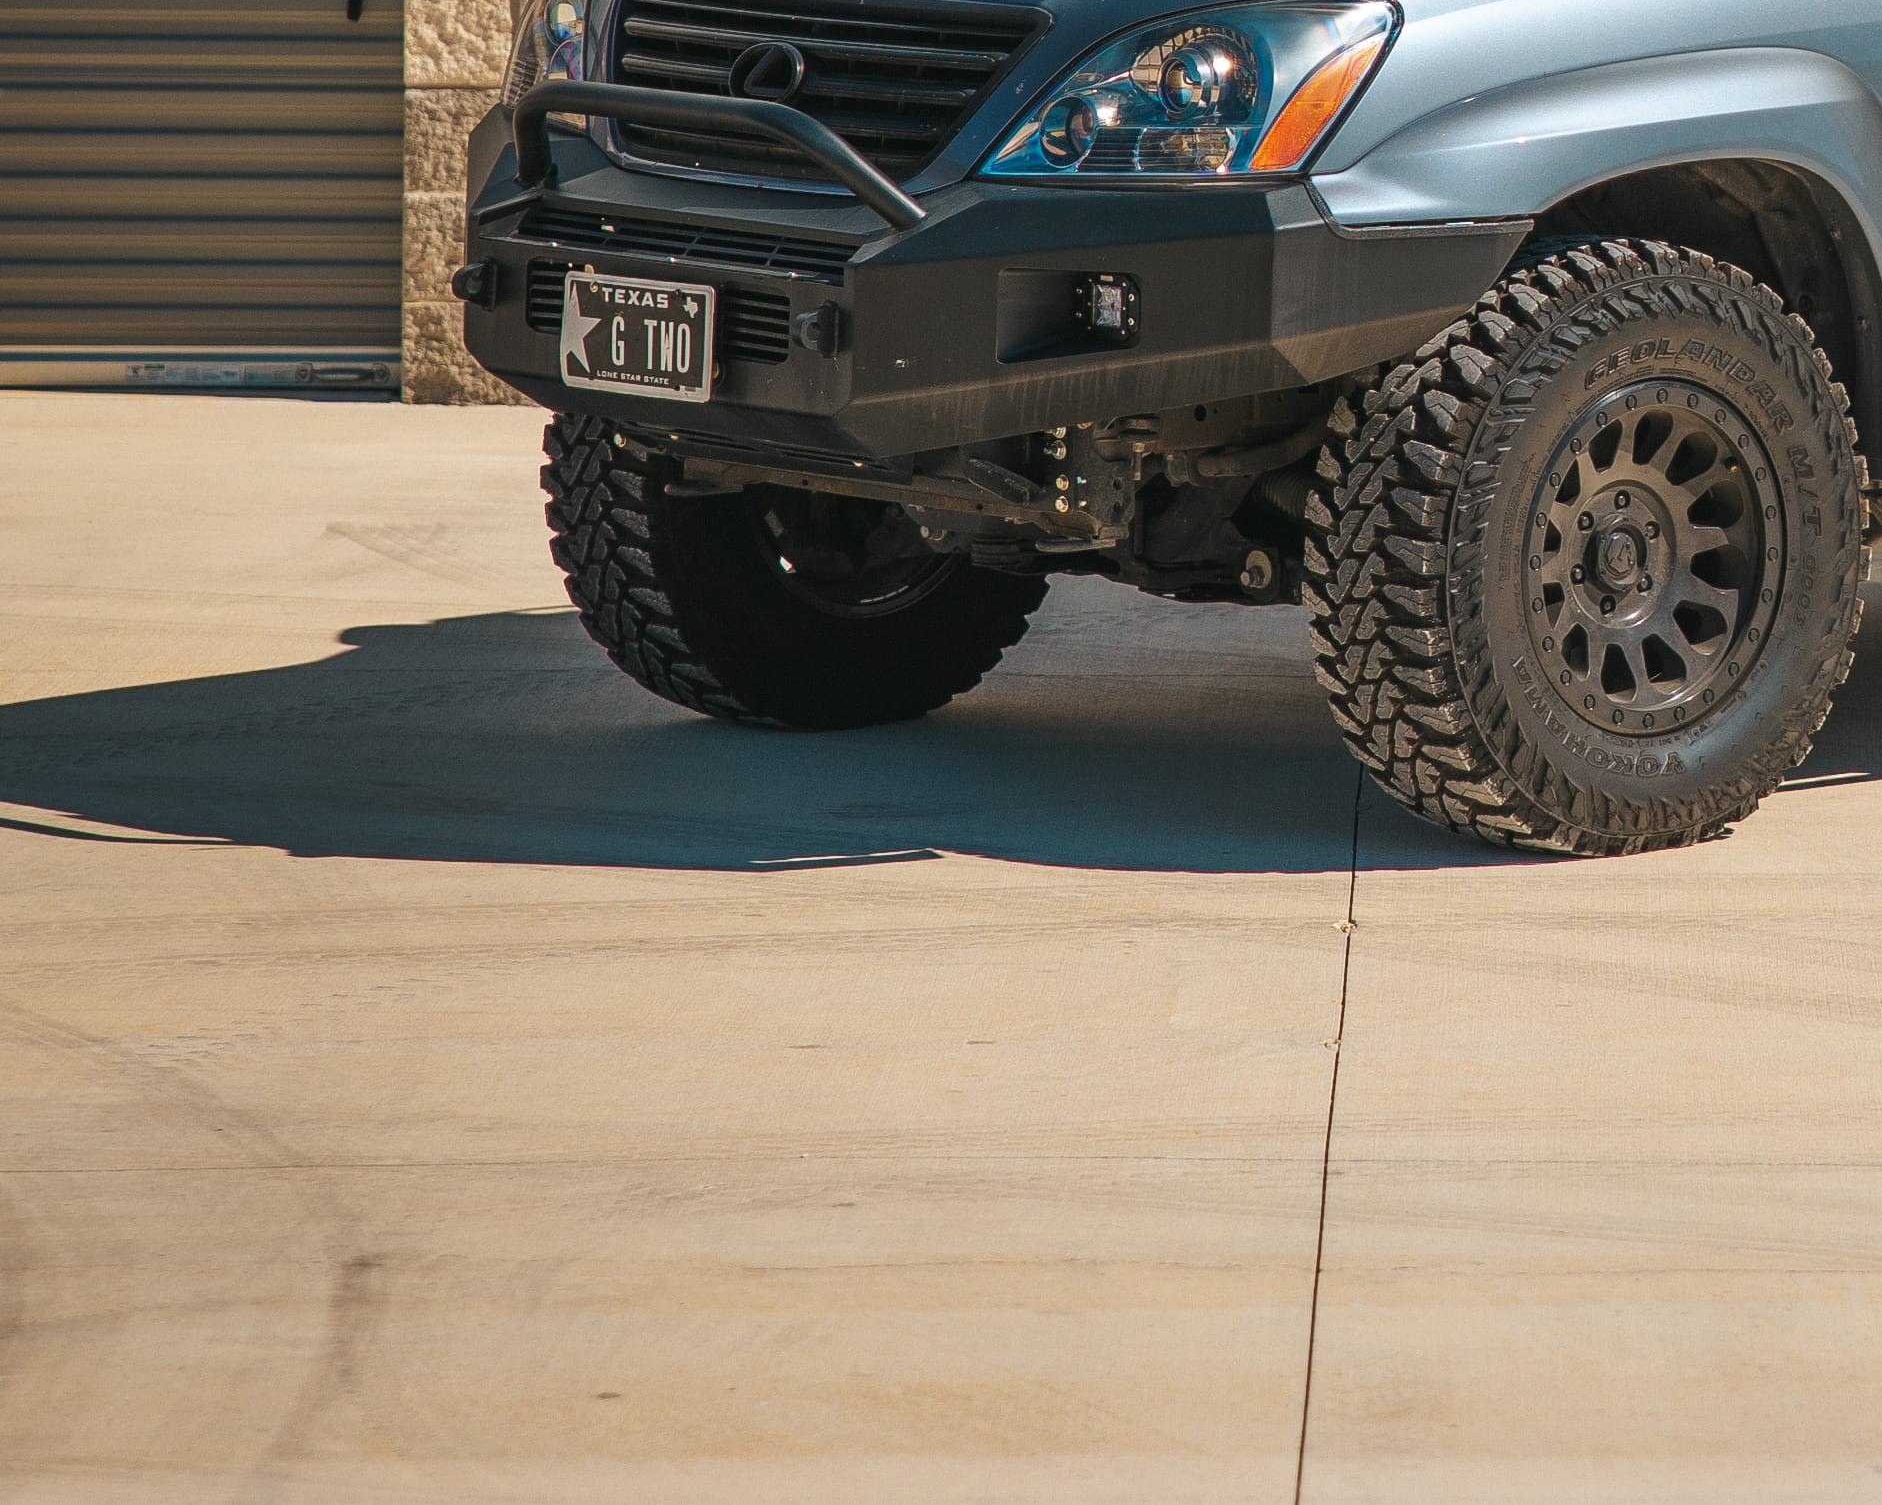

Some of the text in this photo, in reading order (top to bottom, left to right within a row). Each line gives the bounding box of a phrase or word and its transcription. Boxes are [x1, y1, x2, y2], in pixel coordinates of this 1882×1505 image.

[602, 286, 669, 309] TEXAS
[611, 315, 691, 374] G TWO
[596, 370, 670, 385] LONE STAR STATE
[1584, 335, 1795, 433] GEOLANDAR
[1511, 655, 1687, 778] YOKOHAMA
